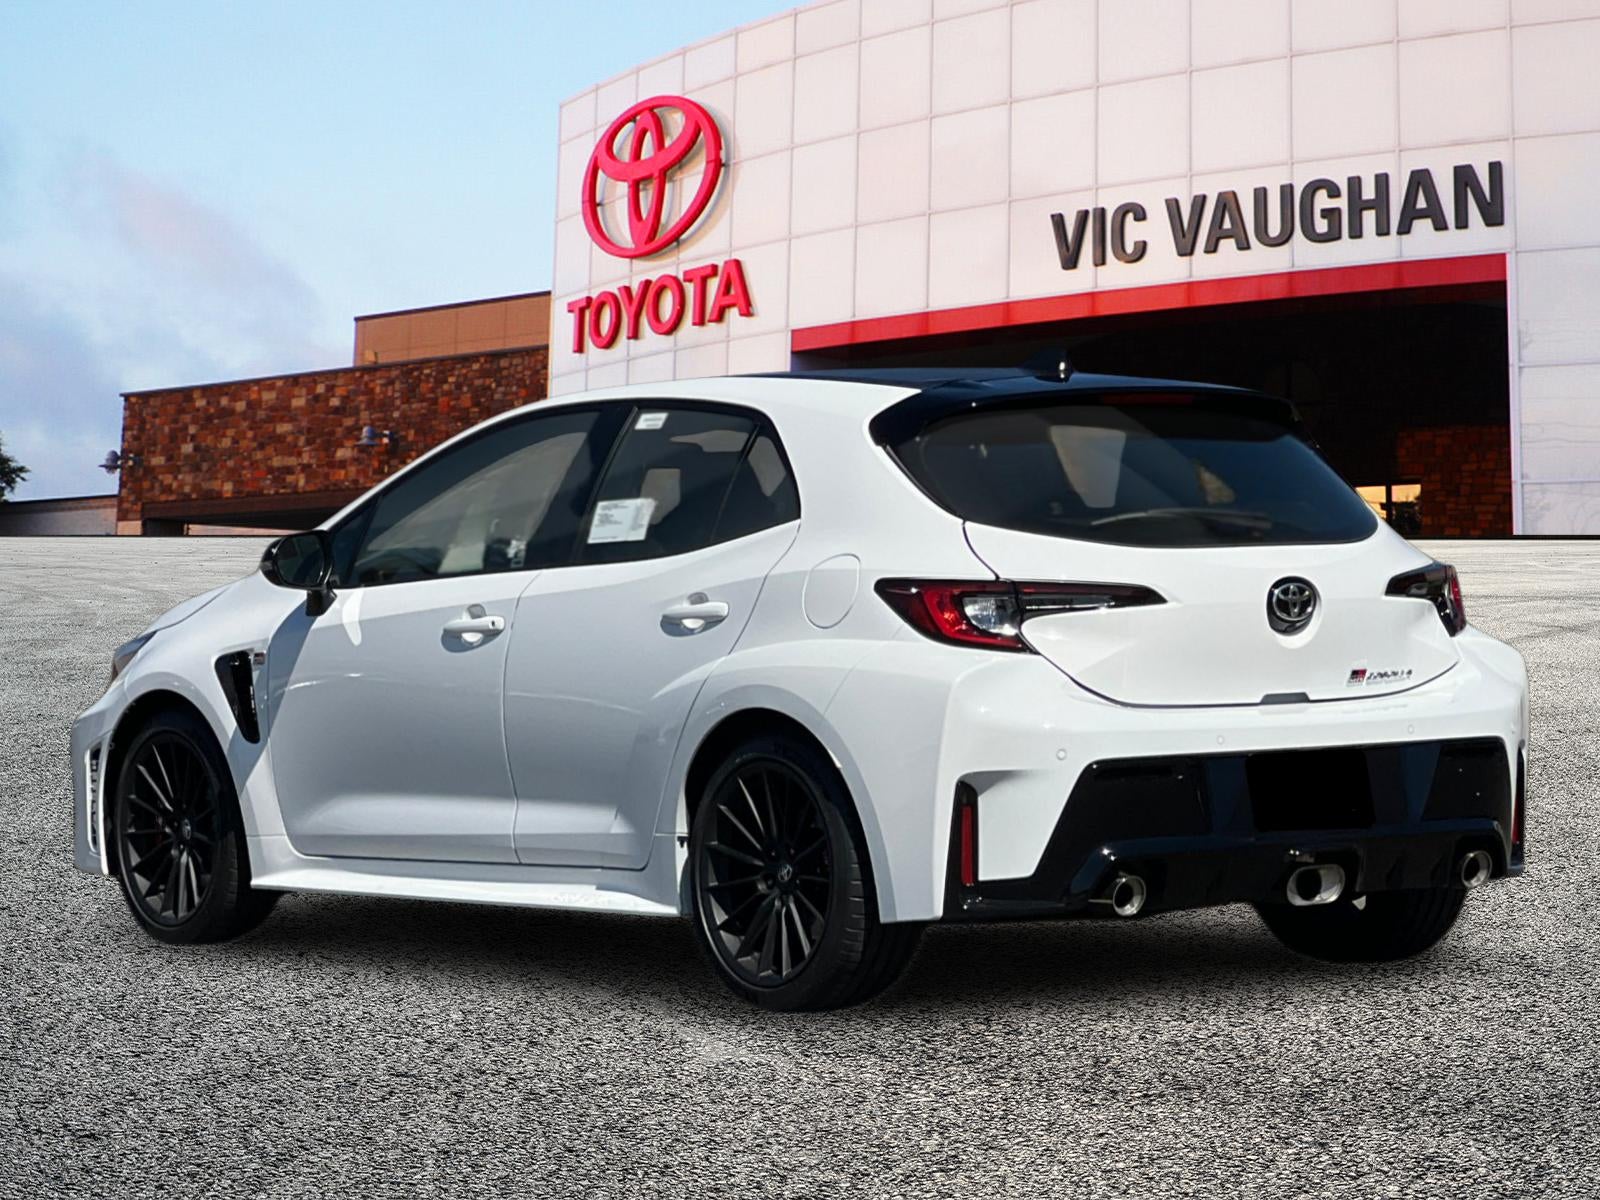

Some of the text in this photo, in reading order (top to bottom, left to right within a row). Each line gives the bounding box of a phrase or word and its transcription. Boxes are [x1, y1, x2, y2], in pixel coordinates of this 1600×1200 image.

[1050, 160, 1505, 271] VIC VAUGHAN
[567, 258, 753, 354] TOYOTA
